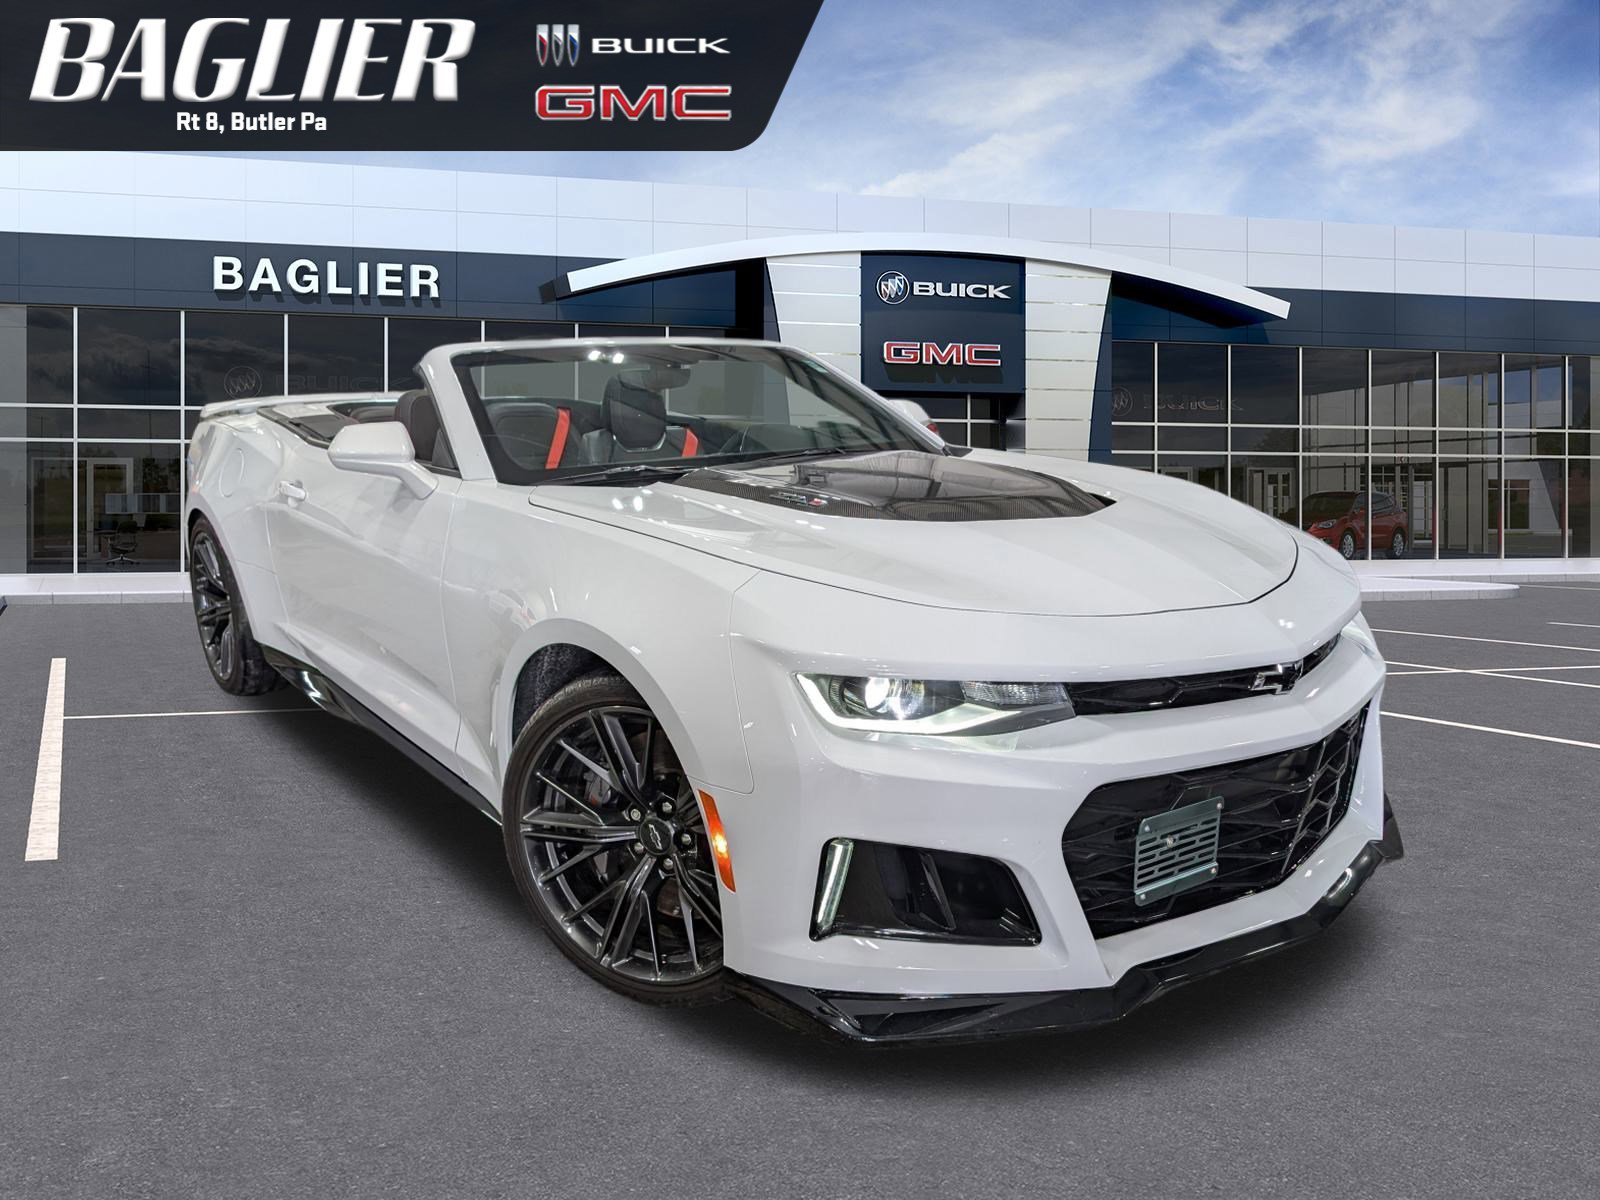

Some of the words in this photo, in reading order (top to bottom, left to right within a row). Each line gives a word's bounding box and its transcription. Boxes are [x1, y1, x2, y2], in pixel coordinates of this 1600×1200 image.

[213, 255, 440, 298] BAGLIER
[913, 281, 1012, 299] BUICK
[883, 341, 1001, 366] GMC
